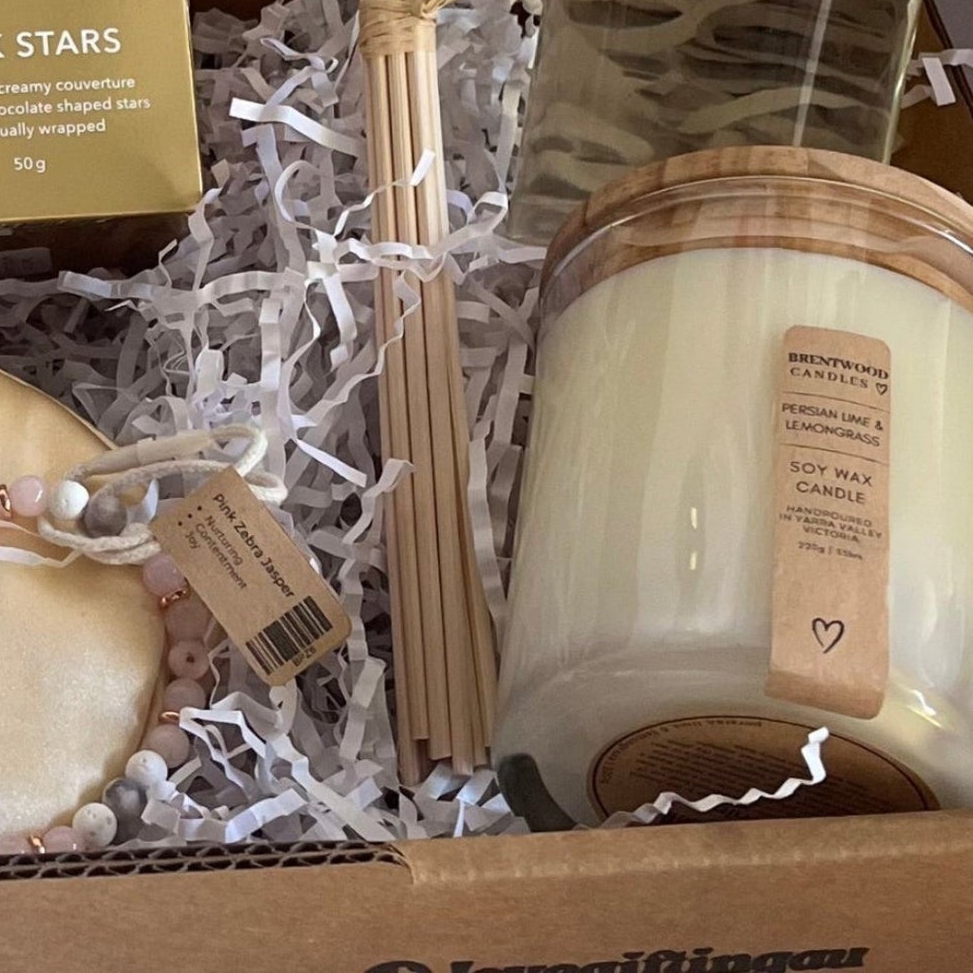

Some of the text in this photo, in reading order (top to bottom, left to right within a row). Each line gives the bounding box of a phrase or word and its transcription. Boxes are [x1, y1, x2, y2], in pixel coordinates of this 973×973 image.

[16, 28, 122, 58] STARS
[56, 77, 136, 92] couverture
[56, 98, 112, 116] shaped
[116, 96, 151, 110] stars
[38, 118, 106, 137] wrapped
[788, 352, 889, 380] BRENTWOOD
[790, 367, 868, 388] CANDLES
[782, 403, 838, 420] PERSIAN
[842, 412, 871, 427] LIME
[786, 420, 880, 447] LEMONGRASS
[790, 461, 873, 487] SOY WAX
[796, 481, 865, 505] CANDLE
[786, 505, 873, 527] HANDPOURED
[184, 531, 200, 551] Joy
[205, 514, 244, 567] Nurturing
[802, 526, 859, 543] VICTORIA
[839, 522, 882, 538] VALLEY
[195, 522, 247, 590] Contentment
[212, 493, 295, 598] Pink Zebra Jasper
